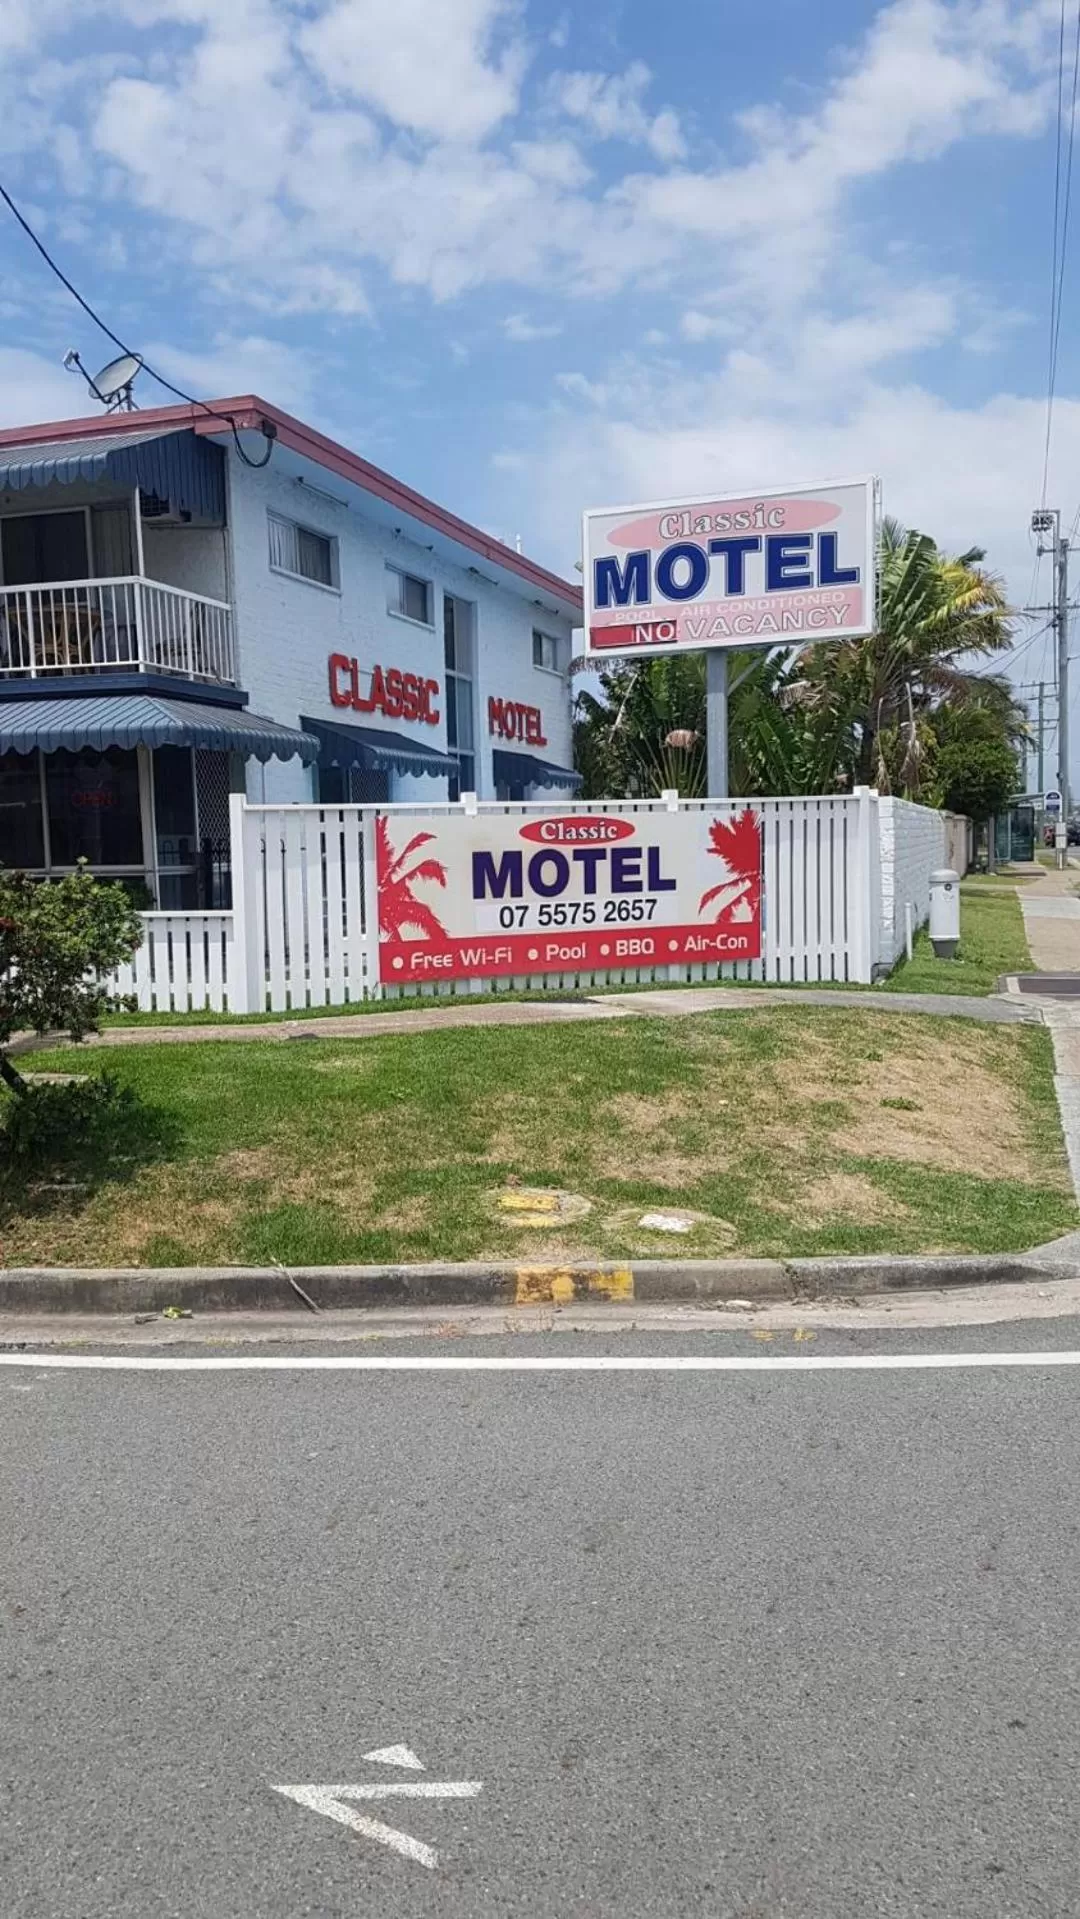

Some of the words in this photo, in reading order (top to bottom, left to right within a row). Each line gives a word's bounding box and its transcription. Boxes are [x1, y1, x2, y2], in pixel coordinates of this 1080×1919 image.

[659, 503, 785, 540] Classic
[593, 531, 860, 609] MOTEL
[615, 609, 660, 622] POOL
[680, 604, 712, 616] AIR
[716, 591, 845, 614] CONDITIONED
[634, 622, 675, 643] NO
[685, 604, 850, 639] VACANCY
[328, 652, 440, 726] CLASSIC
[488, 695, 548, 747] MOTEL
[540, 822, 618, 841] Classic
[472, 846, 676, 899] MOTEL
[499, 905, 529, 928] 07
[538, 901, 596, 926] 5575
[604, 899, 657, 922] 2657
[460, 947, 512, 966] Wi-Fi
[546, 942, 586, 961] Pool
[615, 938, 655, 957] BBQ
[684, 935, 748, 952] Air-Con
